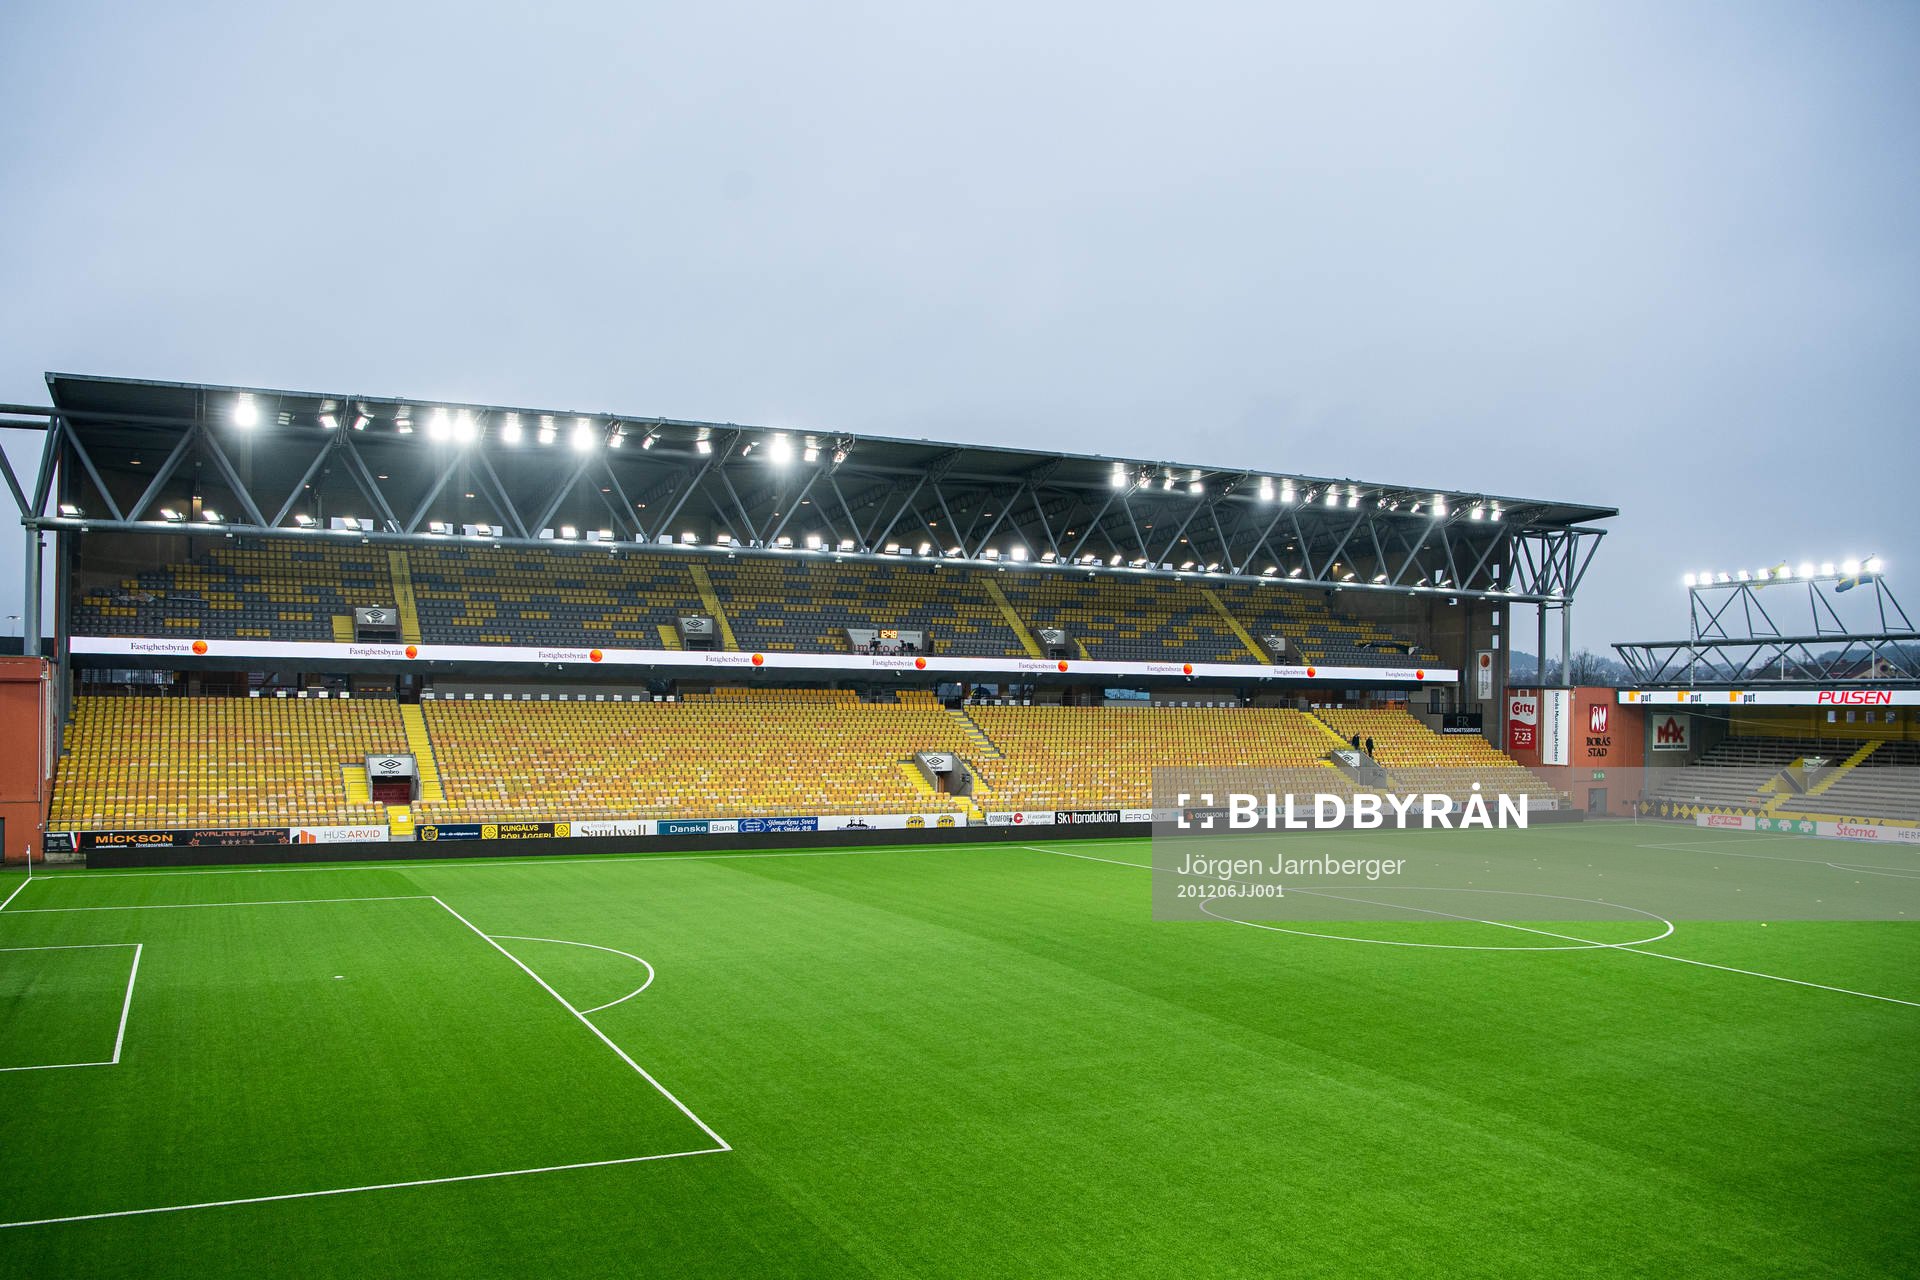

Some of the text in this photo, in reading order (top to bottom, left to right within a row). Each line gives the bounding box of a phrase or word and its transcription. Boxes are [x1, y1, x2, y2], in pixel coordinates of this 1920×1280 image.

[131, 642, 189, 653] Fastighetsbyrån
[349, 647, 403, 657] Fastighetsbyrån
[538, 651, 588, 661] Fastighetsbyrån
[1817, 691, 1892, 704] PULSEN
[1657, 716, 1685, 743] MAX
[1125, 813, 1167, 821] FRONT
[500, 824, 539, 832] KUNGÄLVS
[669, 825, 707, 833] Danske
[711, 824, 736, 832] Bank
[323, 829, 381, 840] HUSARVID
